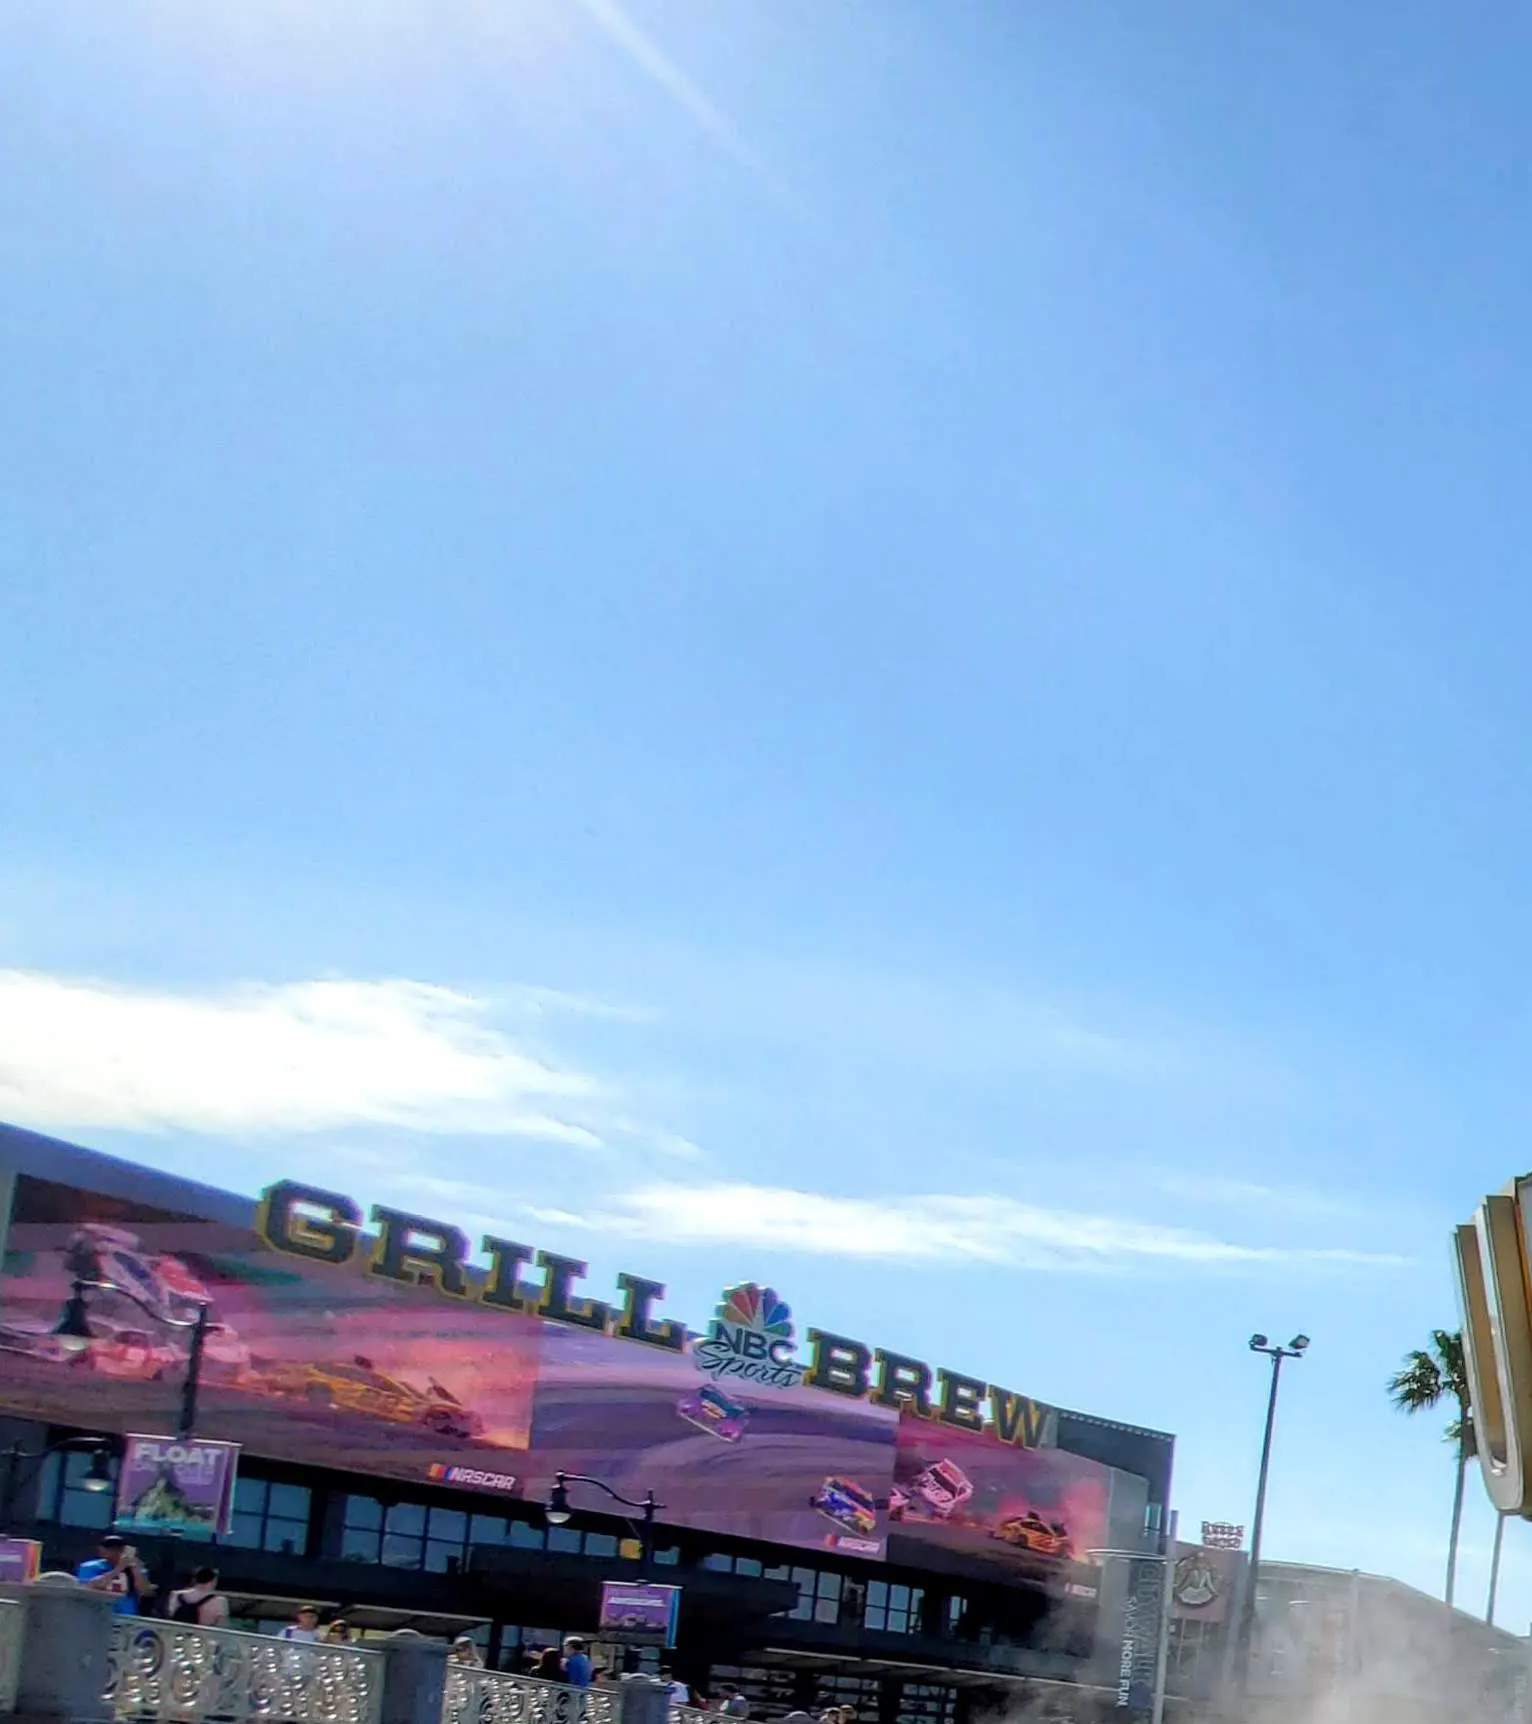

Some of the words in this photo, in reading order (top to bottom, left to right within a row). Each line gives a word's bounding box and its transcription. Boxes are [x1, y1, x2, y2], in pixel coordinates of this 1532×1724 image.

[257, 1178, 690, 1354] GRILL
[804, 1327, 1056, 1450] BREW
[697, 1340, 802, 1387] Sports
[716, 1322, 798, 1366] NBC
[134, 1442, 222, 1464] FLOAT
[450, 1466, 516, 1490] NASCAR
[1120, 1639, 1135, 1677] MORE
